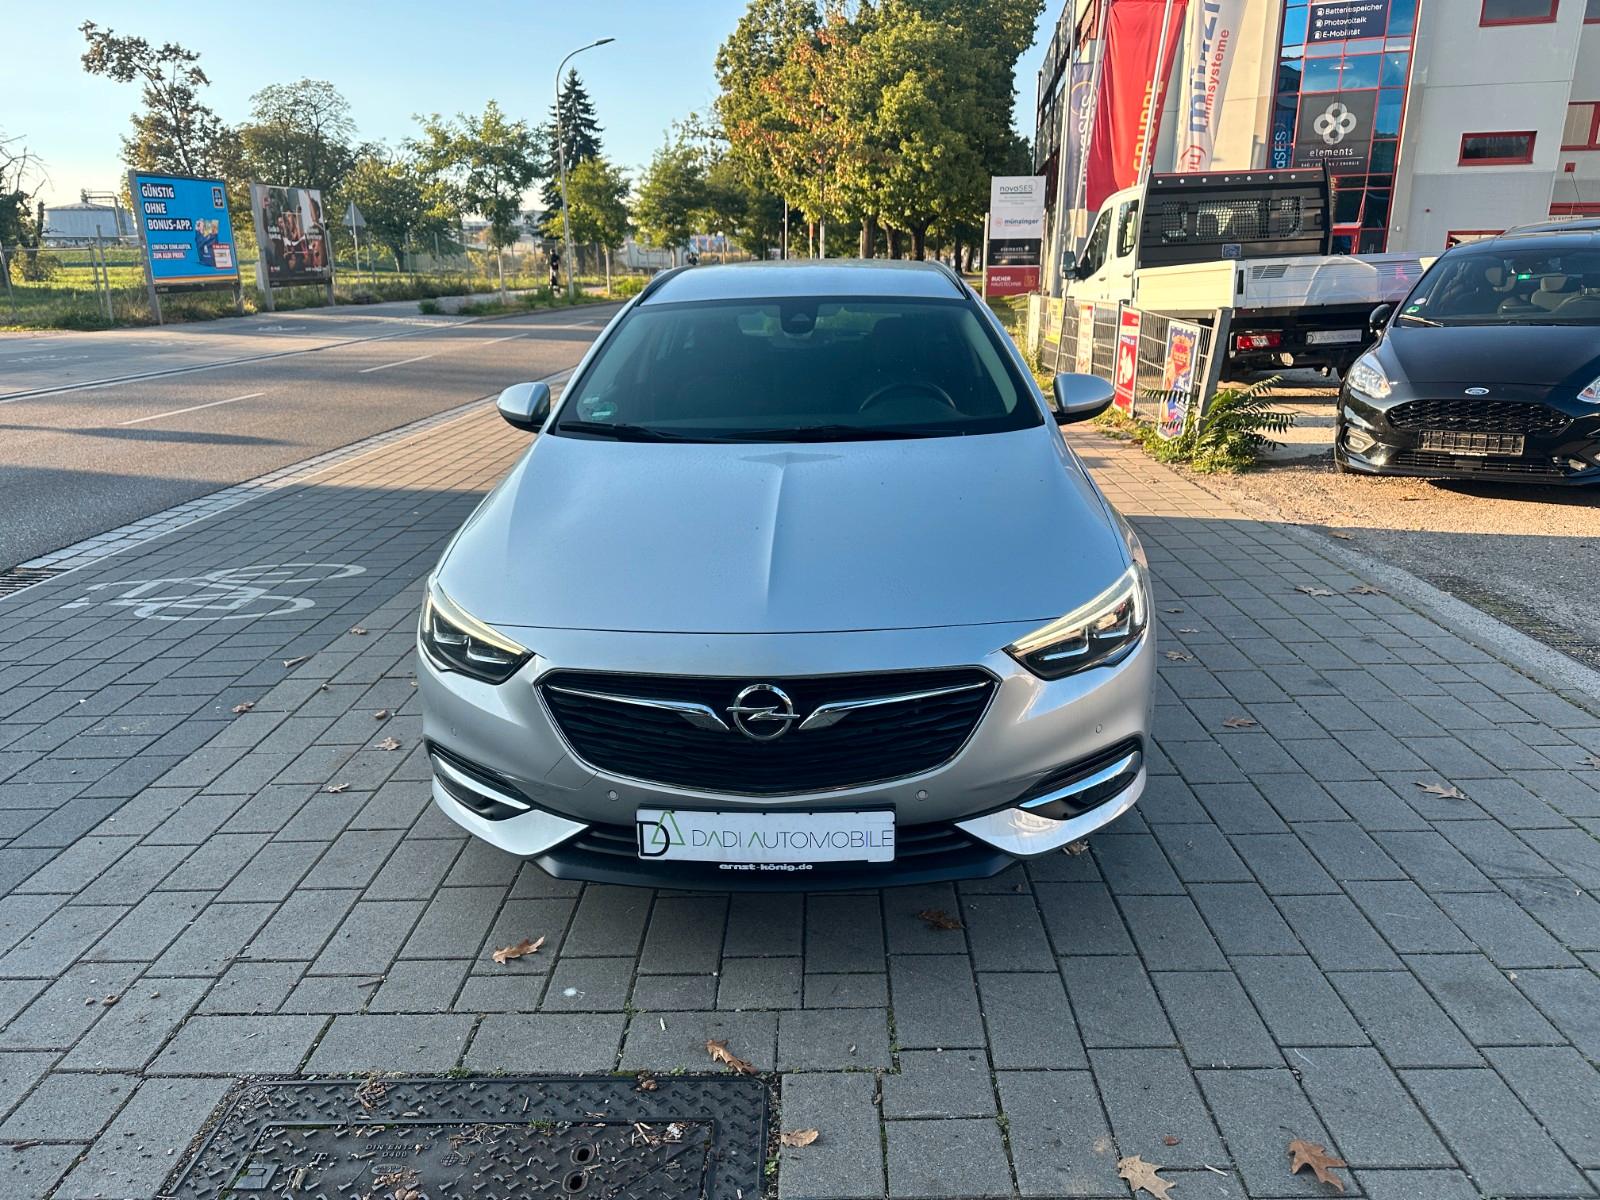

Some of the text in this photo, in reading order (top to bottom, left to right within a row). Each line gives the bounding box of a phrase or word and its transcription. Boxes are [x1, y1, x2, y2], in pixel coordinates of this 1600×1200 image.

[1309, 147, 1353, 157] elements
[141, 184, 174, 198] GÜNSTIG
[145, 202, 167, 214] OHNE
[148, 219, 192, 230] BONUS-APP.
[1004, 217, 1039, 226] münzinger
[692, 829, 894, 849] DADI AUTOMOBILE
